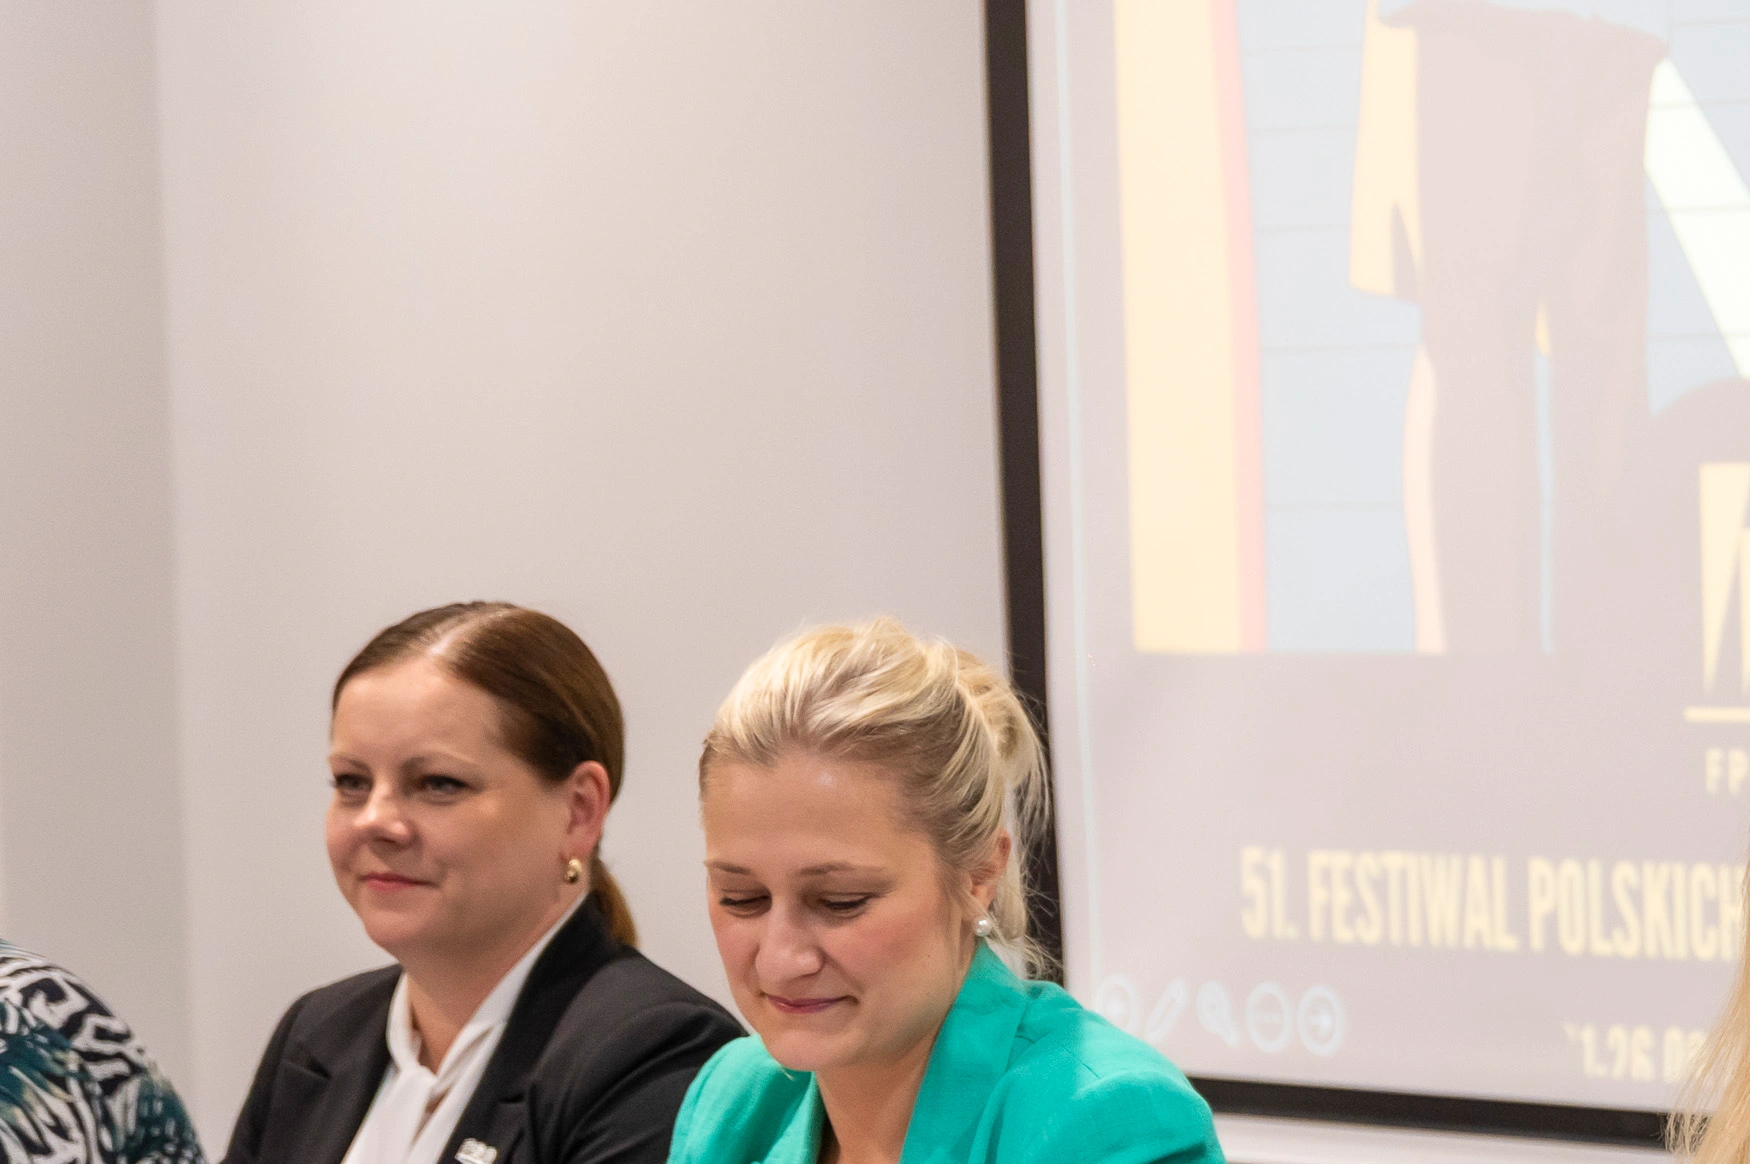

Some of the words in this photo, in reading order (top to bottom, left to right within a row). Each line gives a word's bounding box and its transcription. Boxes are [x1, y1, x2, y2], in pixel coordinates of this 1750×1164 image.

[1241, 846, 1297, 938] 51.
[1308, 850, 1519, 952] FESTIWAL
[1528, 856, 1744, 961] POLSKICH
